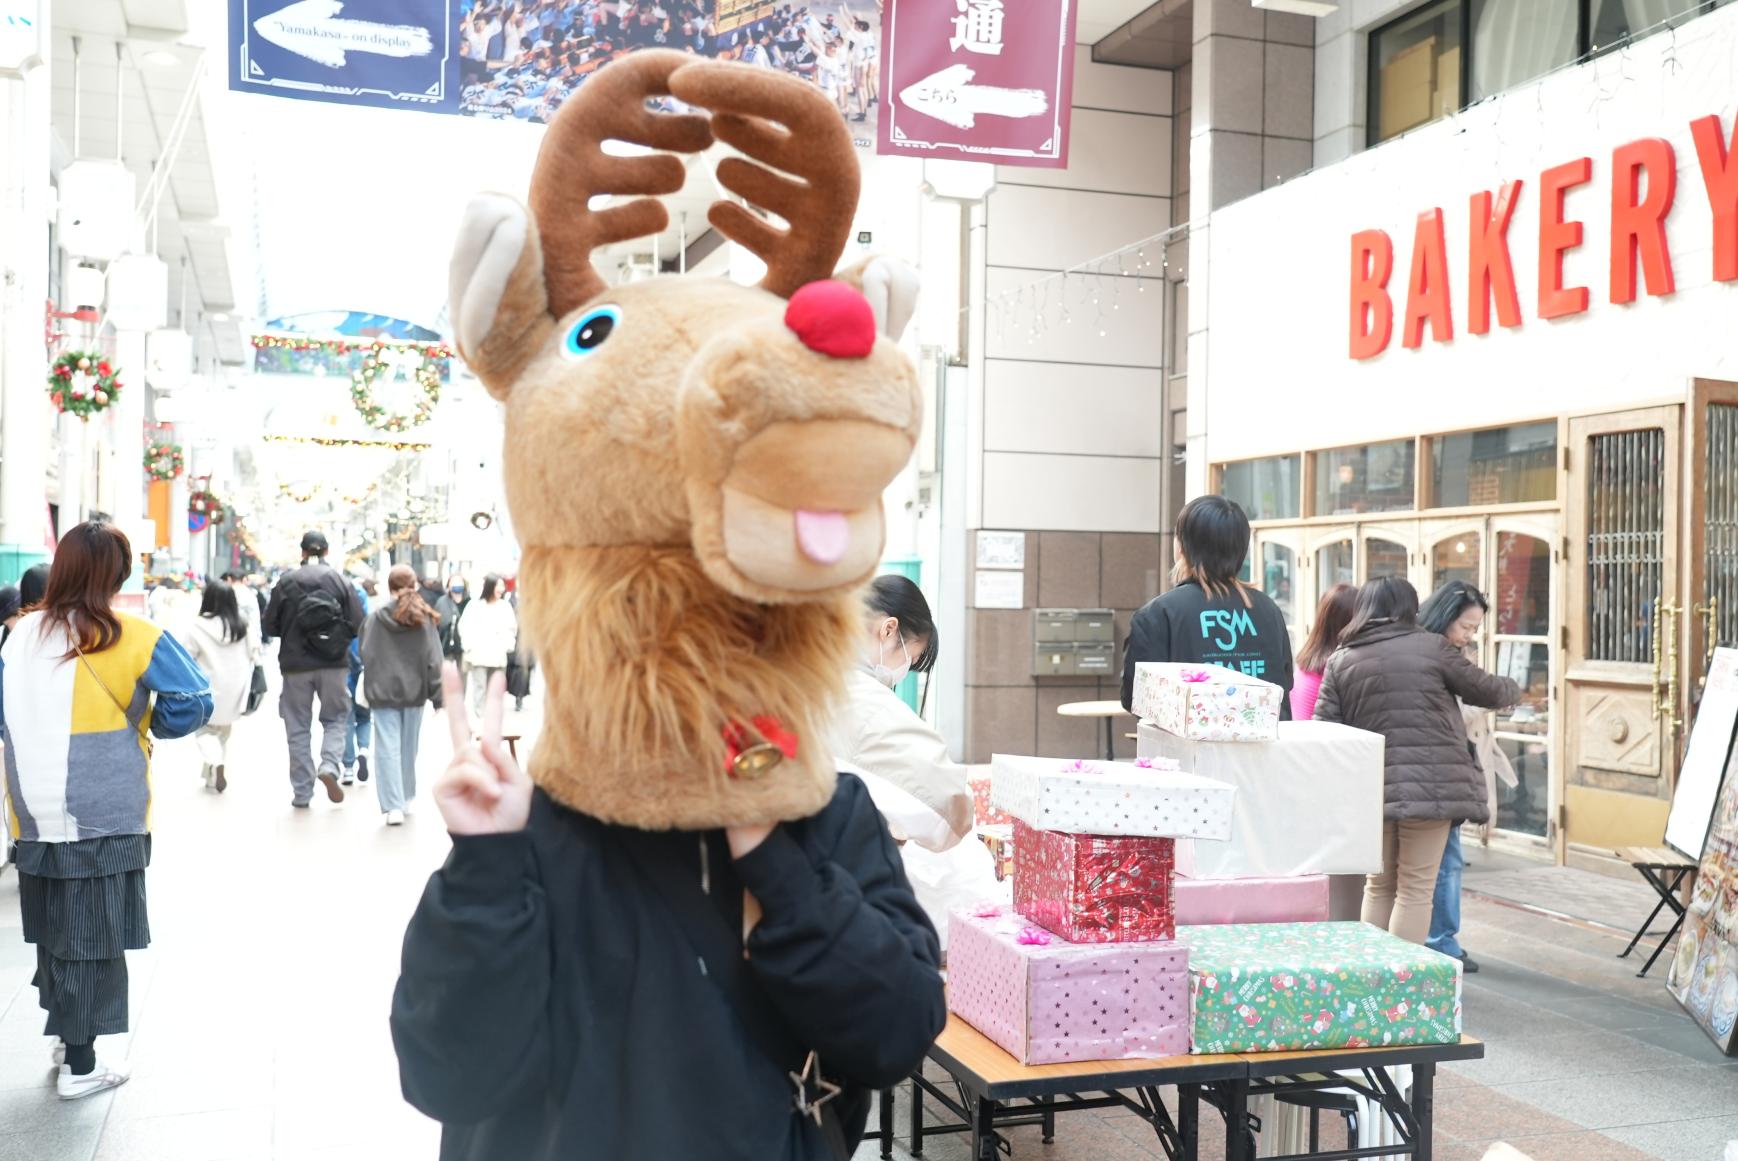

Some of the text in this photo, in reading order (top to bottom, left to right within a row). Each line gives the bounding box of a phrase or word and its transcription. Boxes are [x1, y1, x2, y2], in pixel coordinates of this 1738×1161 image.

[351, 33, 367, 42] on
[369, 33, 411, 49] display
[948, 0, 1005, 55] 通
[917, 87, 958, 105] こちら
[1349, 106, 1738, 360] BAKERY
[1199, 608, 1258, 650] FSM
